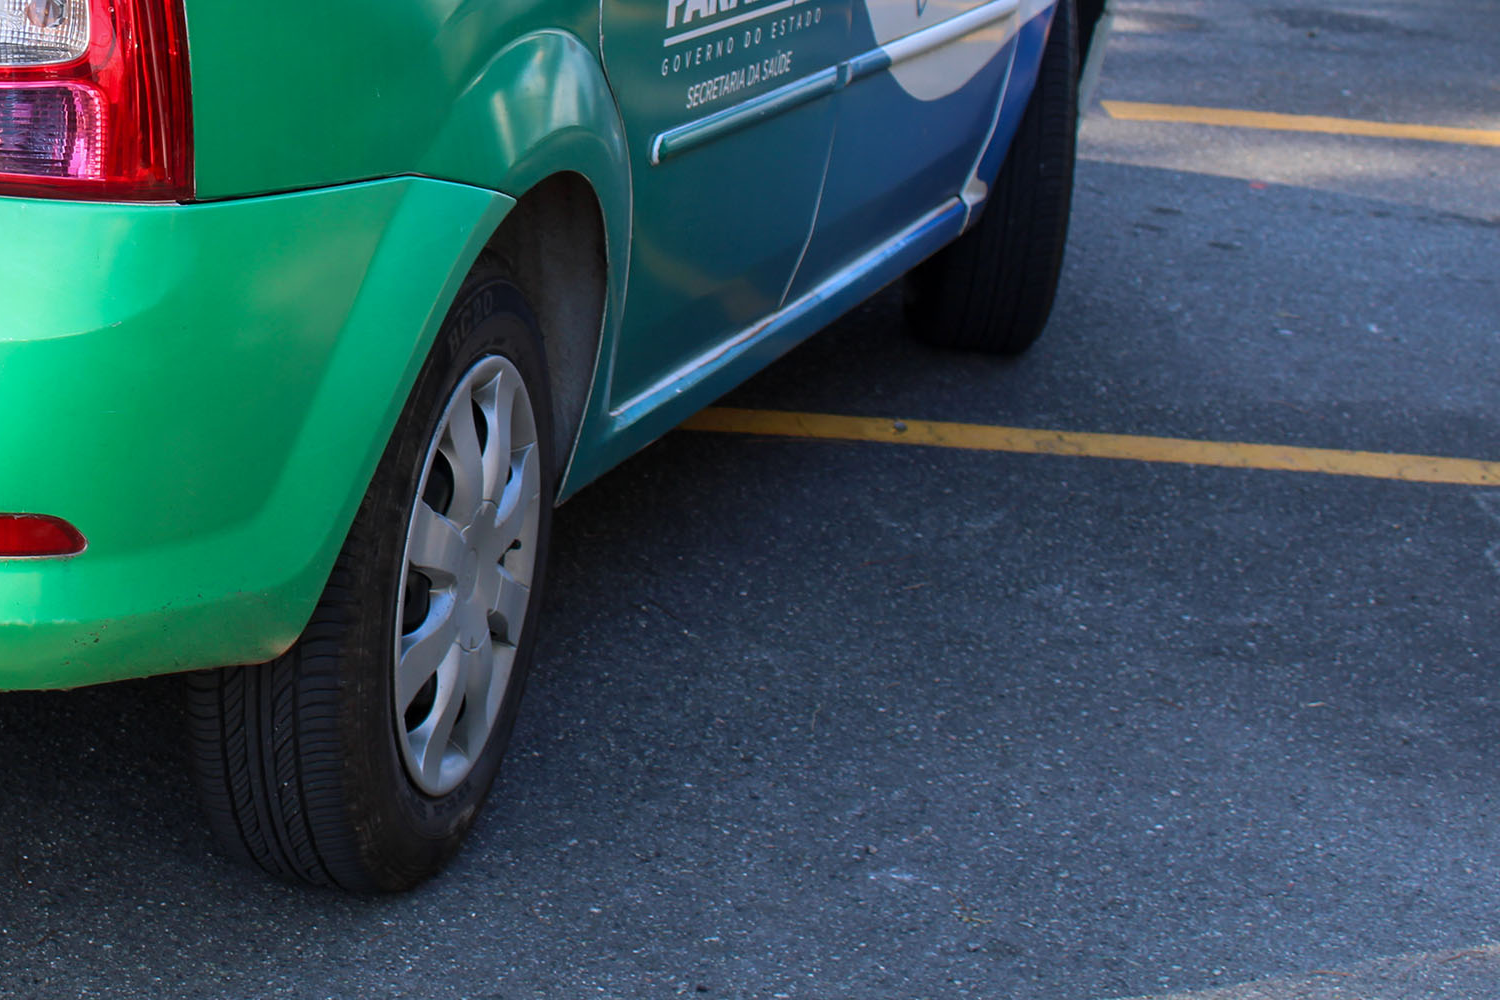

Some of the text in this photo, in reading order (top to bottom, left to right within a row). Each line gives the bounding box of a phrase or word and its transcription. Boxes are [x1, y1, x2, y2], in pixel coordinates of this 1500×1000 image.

[661, 8, 821, 76] GOVERNO DO ESTADO
[686, 50, 794, 109] SECRETARIA DA SAÚDE
